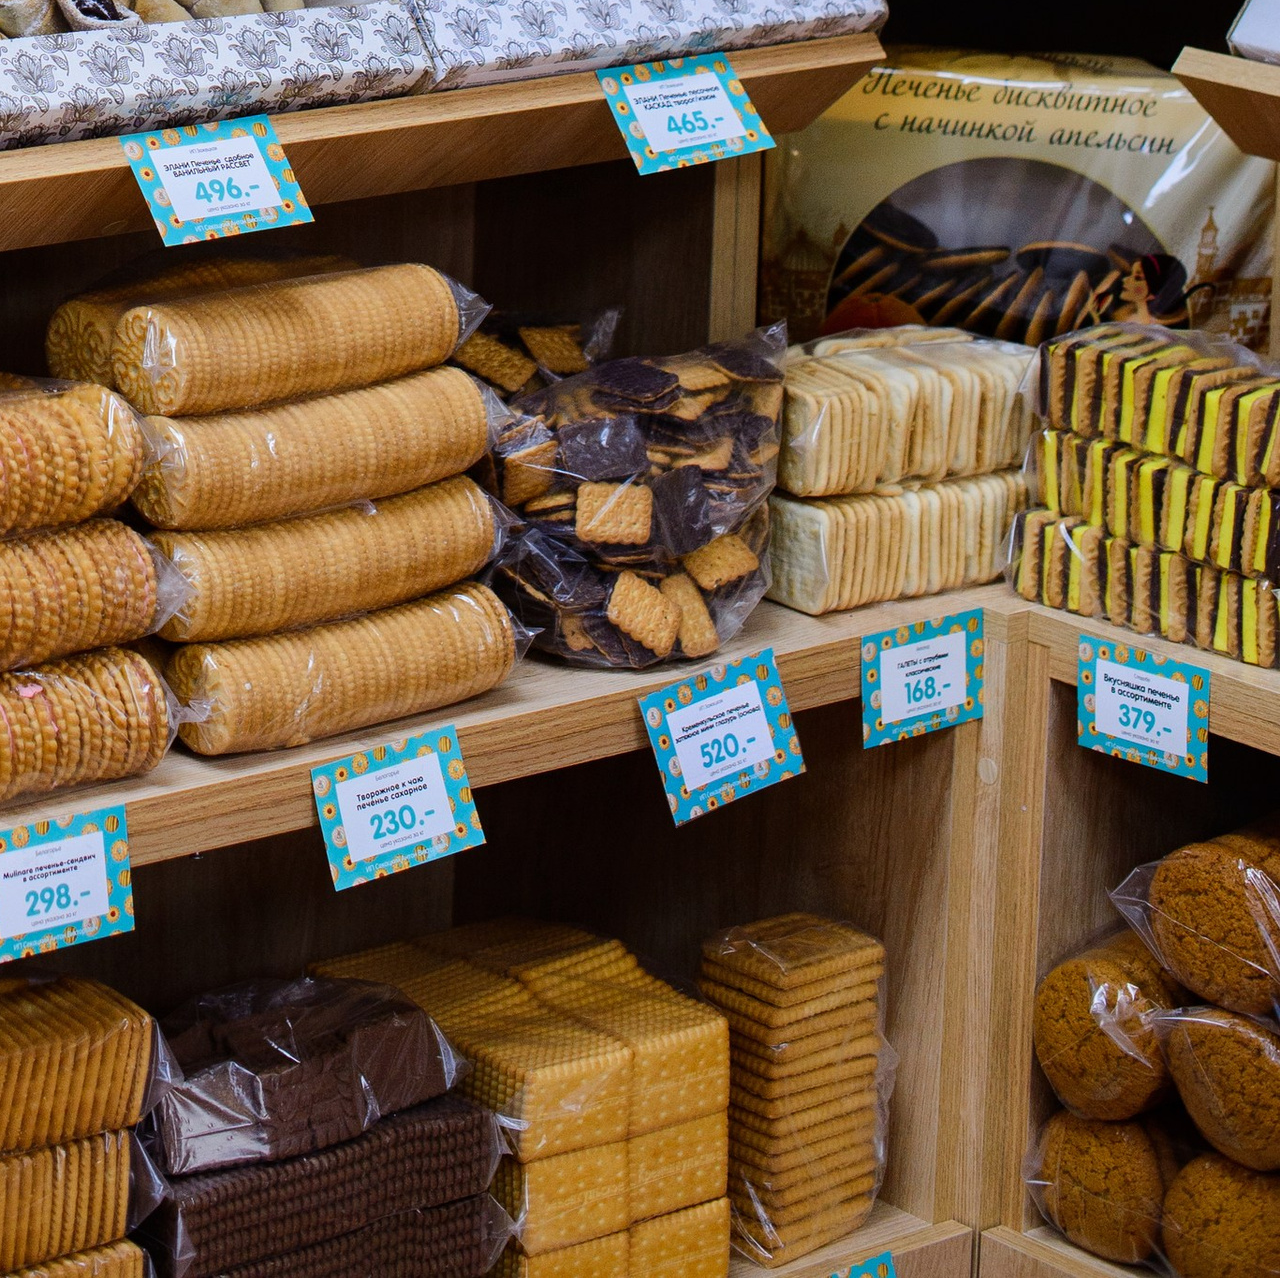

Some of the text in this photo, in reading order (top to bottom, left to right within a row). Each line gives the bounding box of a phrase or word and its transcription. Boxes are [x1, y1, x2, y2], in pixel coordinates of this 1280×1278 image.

[633, 86, 720, 105] ЭЛАНИ Печенье песочное
[862, 68, 1158, 119] Печенье бисквитное
[644, 102, 673, 110] КАСКАД
[873, 113, 1178, 156] с начинкой апельсин
[164, 153, 254, 172] ЭЛАНИ Печенье сдобное
[173, 160, 251, 178] ВАНИЛЬНЫЙ РАССВЕТ
[1104, 673, 1180, 703] Вкусняшка печенье
[1118, 688, 1172, 710] ассортименте
[681, 711, 726, 734] Кременкульское
[726, 702, 750, 715] печенье
[700, 724, 715, 734] мини
[715, 715, 737, 728] глазурь
[356, 784, 400, 803] Творожное
[408, 775, 424, 785] чаю
[356, 783, 428, 811] печенье сахарное
[3, 868, 34, 880] Mulinare
[28, 865, 78, 881] ассортименте
